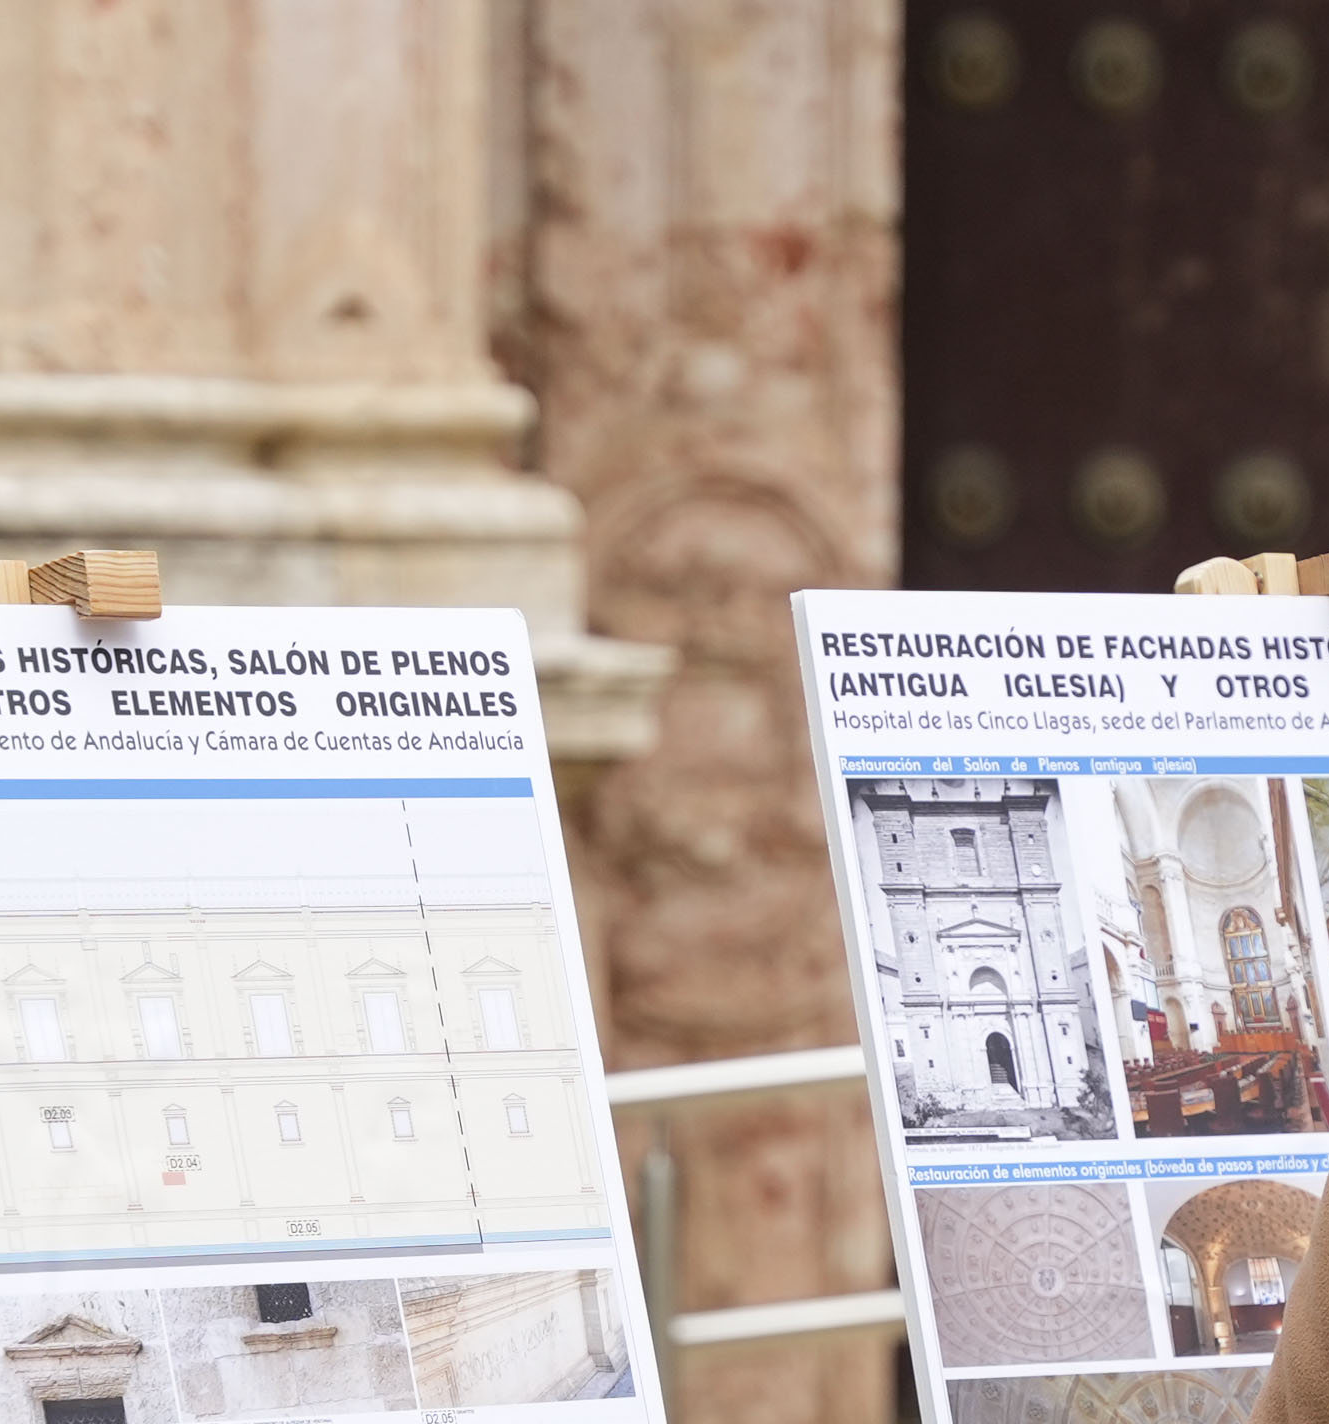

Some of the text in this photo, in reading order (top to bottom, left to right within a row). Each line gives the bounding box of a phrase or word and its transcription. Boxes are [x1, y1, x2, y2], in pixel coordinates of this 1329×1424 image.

[821, 627, 1046, 658] RESTAURACIÓN
[1057, 635, 1093, 658] DE
[1104, 636, 1251, 659] FACHADAS
[17, 639, 218, 681] HISTÓRICAS,
[229, 641, 330, 675] SALÓN
[342, 650, 381, 675] DE
[392, 651, 511, 676] PLENOS
[829, 672, 968, 702] (ANTIGUA
[1004, 674, 1125, 703] IGLESIA)
[1161, 675, 1178, 698] Y
[1216, 675, 1310, 698] OTROS
[111, 690, 297, 717] ELEMENTOS
[336, 690, 517, 717] ORIGINALES
[834, 710, 913, 733] Hospital
[918, 711, 942, 730] de
[947, 710, 972, 730] las
[978, 711, 1029, 730] Cinco
[1033, 711, 1096, 734] Llagas,
[1102, 711, 1146, 730] sede
[1152, 711, 1180, 730] del
[1186, 712, 1286, 730] Parlamento
[1291, 711, 1315, 730] de
[49, 730, 77, 751] de
[83, 730, 183, 751] Andalucía
[188, 736, 200, 755] y
[205, 730, 278, 751] Cámara
[283, 731, 309, 751] de
[315, 731, 392, 751] Cuentas
[397, 731, 422, 751] de
[428, 730, 524, 751] Andalucía
[839, 756, 1197, 774] Restauración del Salón de Plenos (antigua iglesia)
[908, 1156, 1319, 1182] Restauración de elementos originales (bóveda de pasos perdidos y
[290, 1221, 318, 1234] D2.05
[425, 1413, 454, 1424] D2.05
